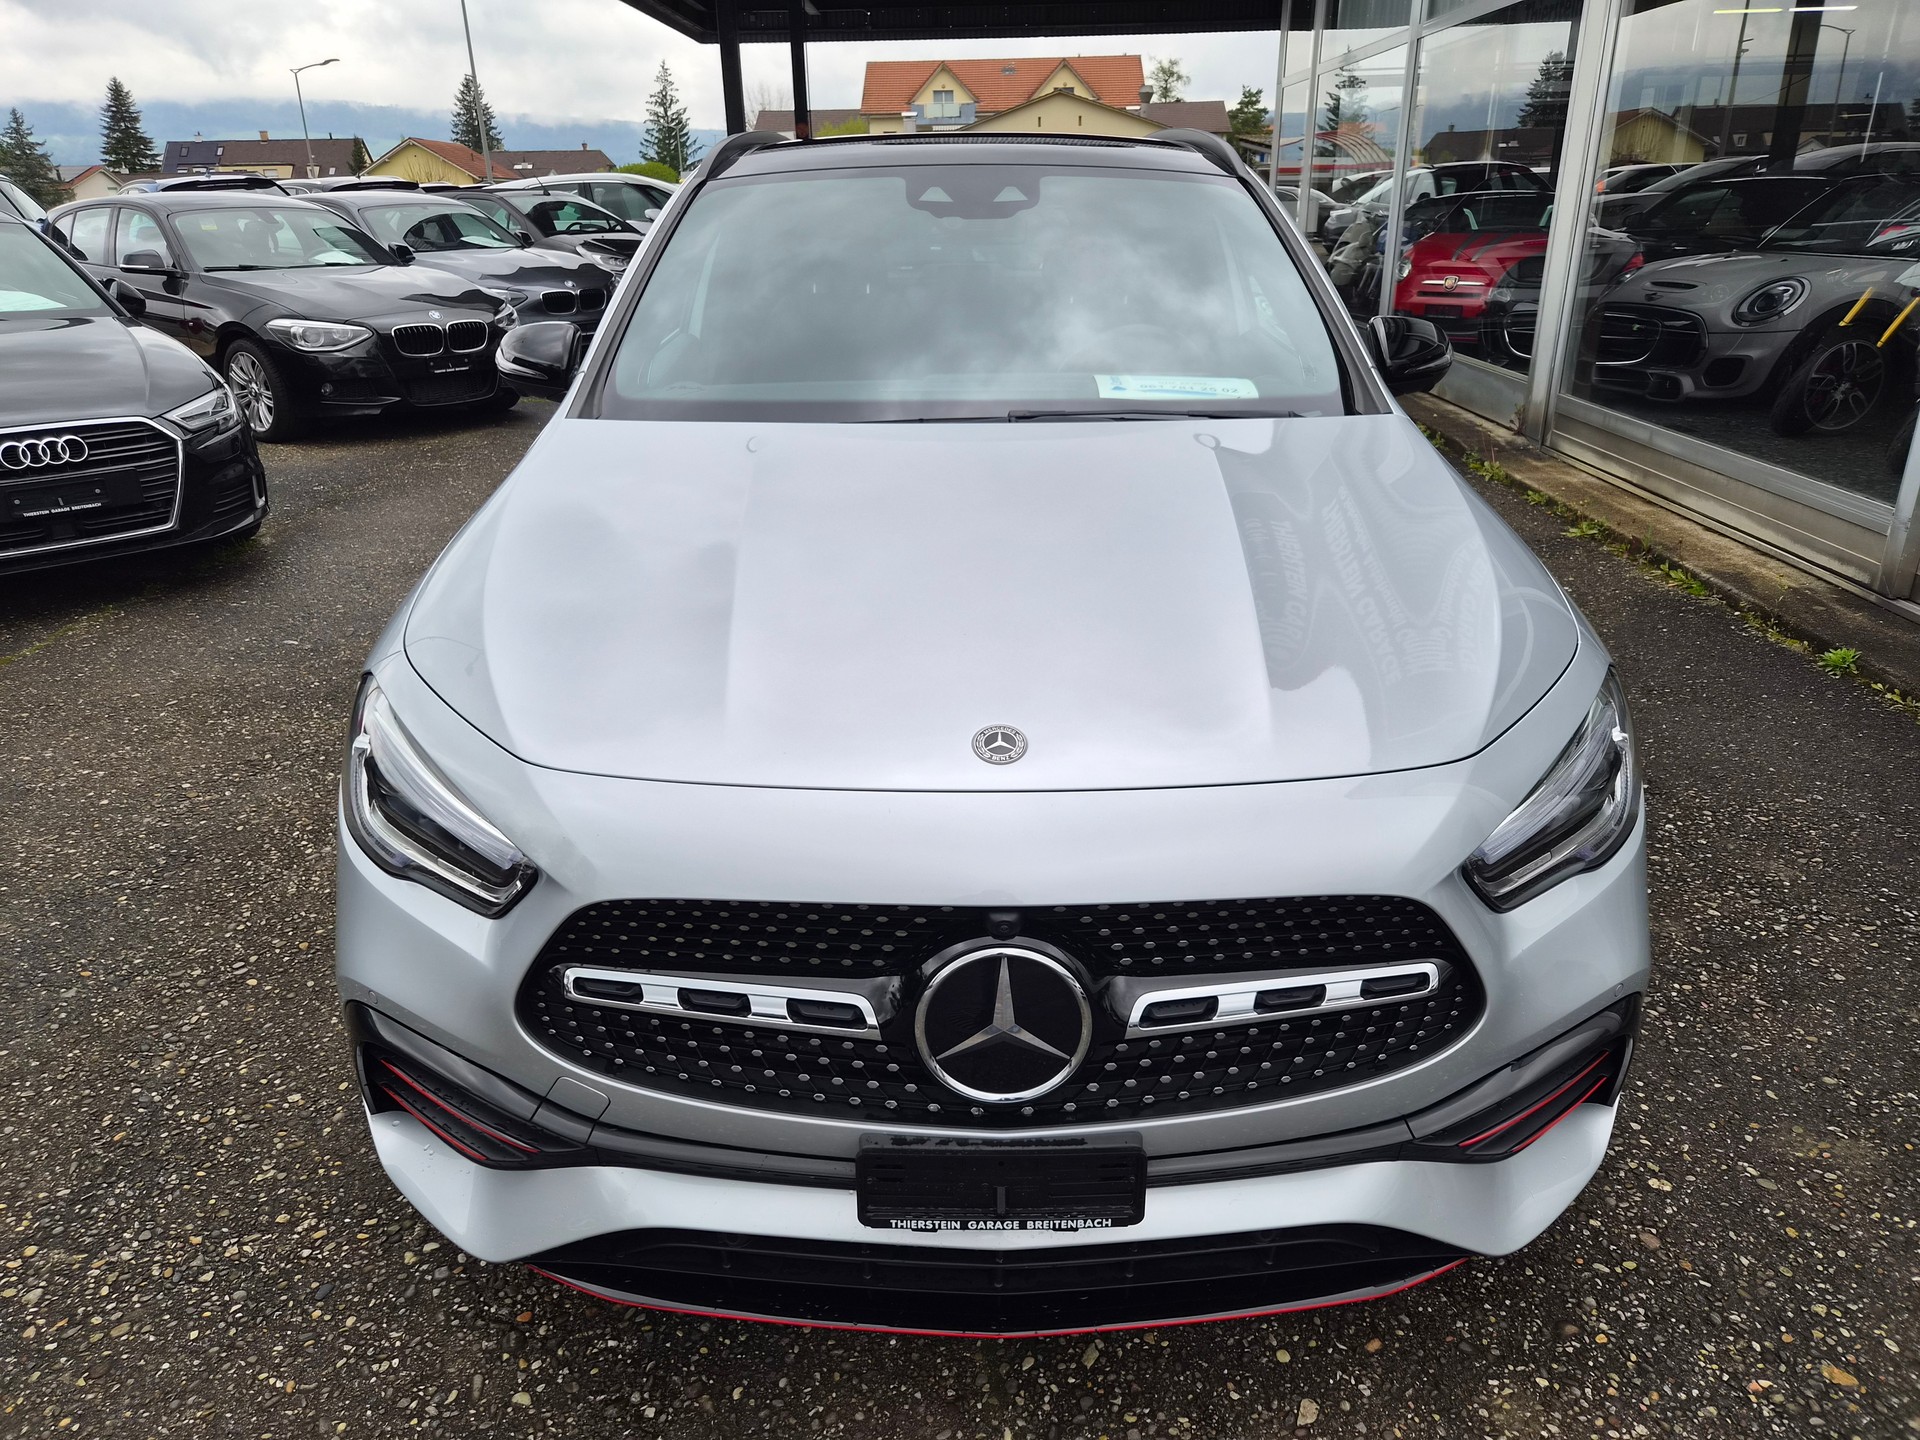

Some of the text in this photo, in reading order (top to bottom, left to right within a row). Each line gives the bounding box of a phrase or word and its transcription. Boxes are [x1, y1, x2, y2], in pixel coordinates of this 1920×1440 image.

[983, 726, 1017, 734] MERCEDES
[889, 1218, 1112, 1230] THIERSTEIN GARAGE BREITENBACH
